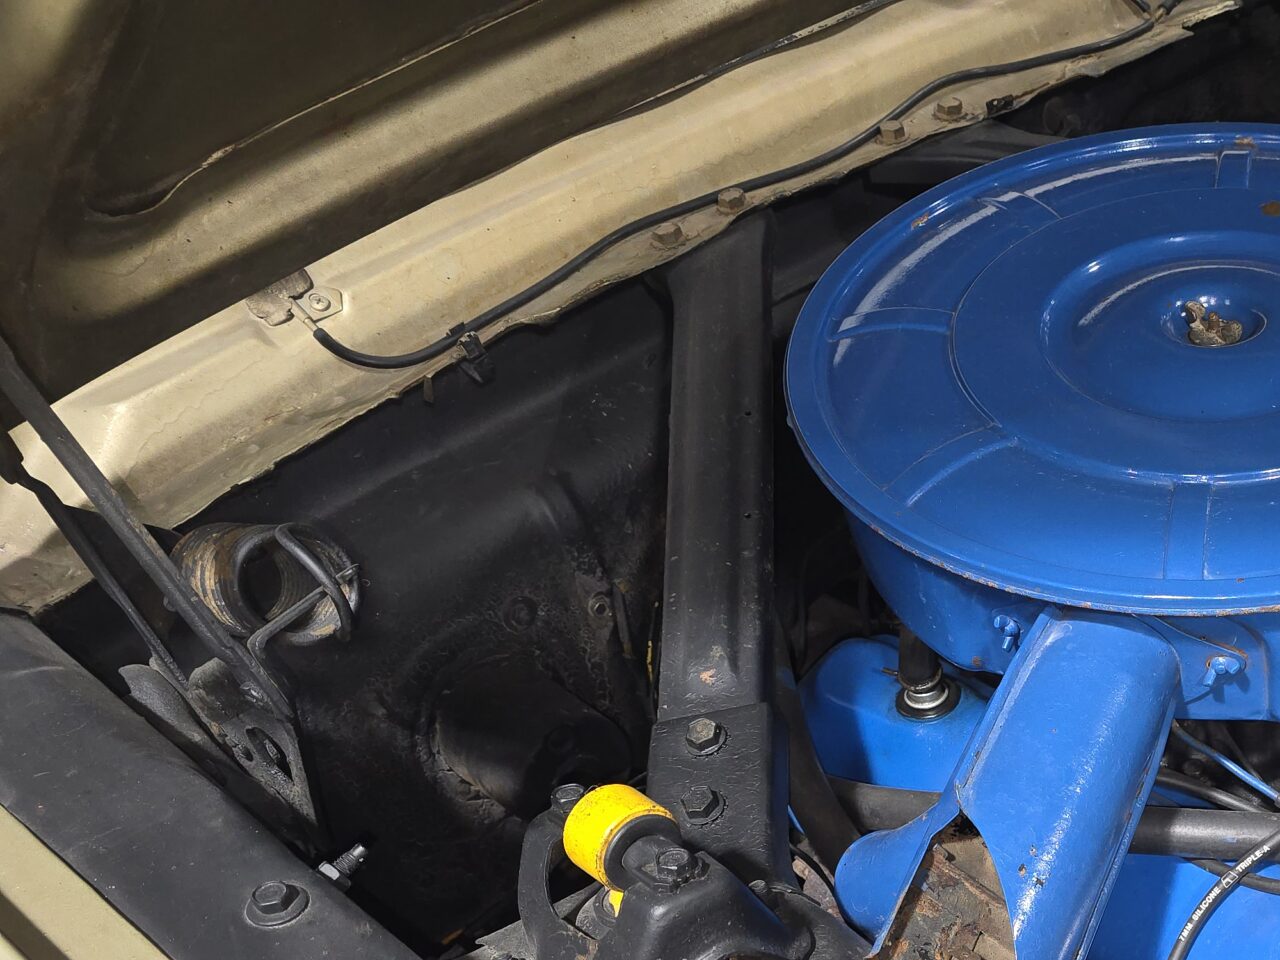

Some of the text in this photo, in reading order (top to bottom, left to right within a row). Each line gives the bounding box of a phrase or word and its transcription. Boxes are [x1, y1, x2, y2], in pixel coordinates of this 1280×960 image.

[1178, 845, 1271, 942] 7MM SILICONE TRIPLE-A
